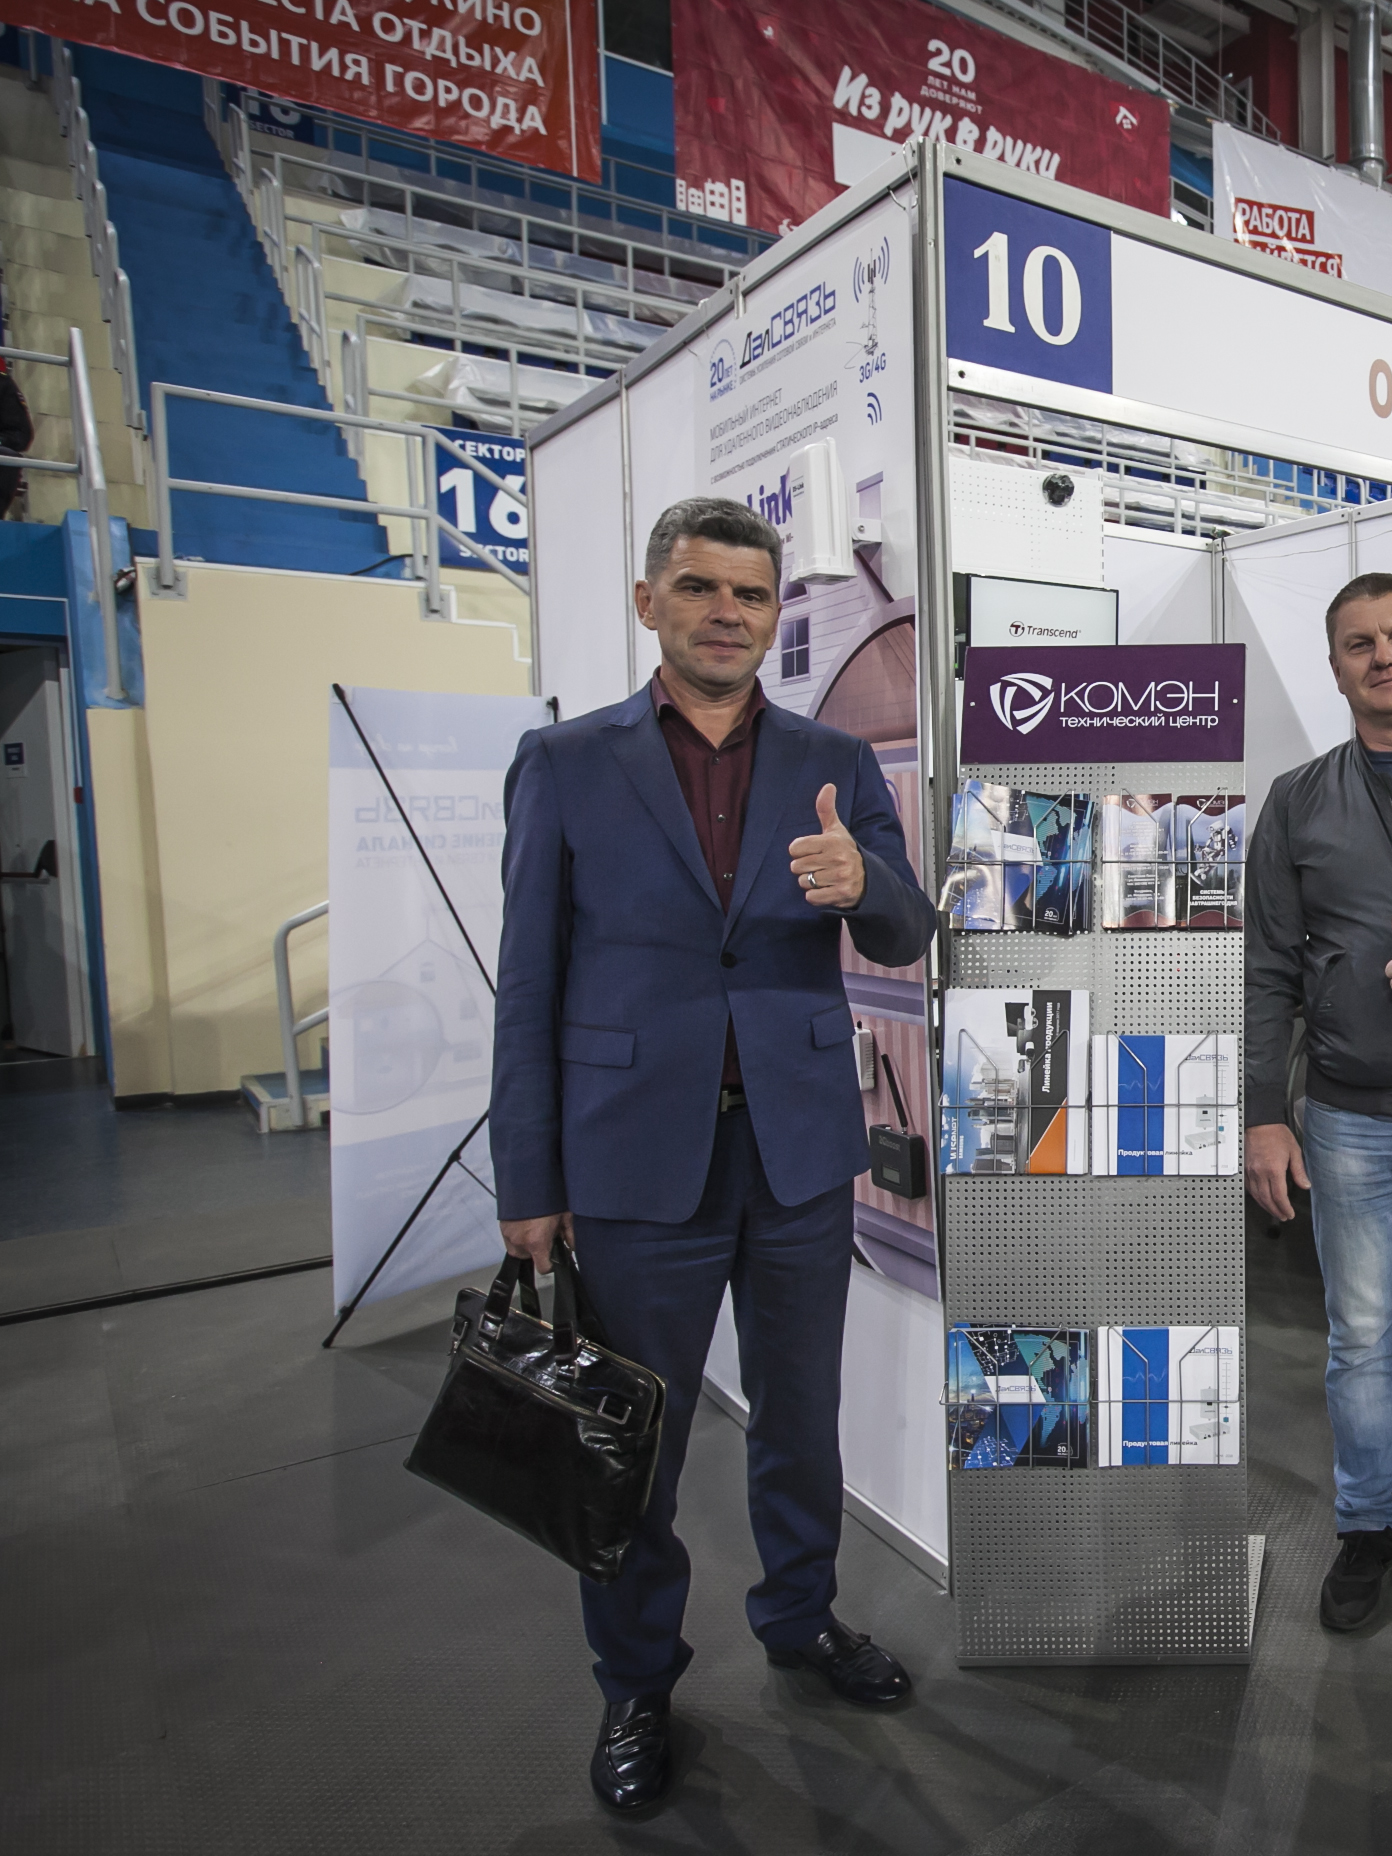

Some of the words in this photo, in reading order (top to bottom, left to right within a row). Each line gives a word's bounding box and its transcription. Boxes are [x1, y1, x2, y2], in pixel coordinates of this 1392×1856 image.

[371, 10, 545, 87] ОТДЫХА
[926, 38, 977, 84] 20
[134, 0, 370, 86] СОБЫТИЯ
[384, 63, 548, 136] ГОРОДА
[919, 84, 983, 115] ДОВЕРЯЮТ
[926, 74, 950, 93] ЛЕТ
[951, 82, 977, 101] НАМ
[249, 120, 295, 139] SECTOR
[1236, 202, 1312, 241] РАБОТА
[972, 231, 1082, 346] 10
[709, 357, 725, 388] 20
[859, 352, 887, 384] 3G/4G
[709, 404, 749, 442] МОБИЛЬНЫЙ
[749, 387, 783, 420] ИНТЕРНЕТ
[709, 444, 723, 466] ДЛЯ
[722, 420, 765, 457] УДАЛЕННОГО
[765, 379, 838, 435] ВИДЕОНАБЛЮДЕНИЯ
[439, 467, 528, 539] 16
[459, 544, 530, 562] SCTOR
[1026, 625, 1078, 639] Transcend
[1060, 681, 1219, 713] КОМЭН
[1059, 713, 1165, 728] технический
[1169, 715, 1219, 729] центр
[1044, 910, 1054, 918] 20
[1041, 1053, 1052, 1093] Линейка
[1117, 1149, 1164, 1157] Продуковая
[1057, 1445, 1067, 1453] 20
[1122, 1440, 1168, 1448] Продутовая
